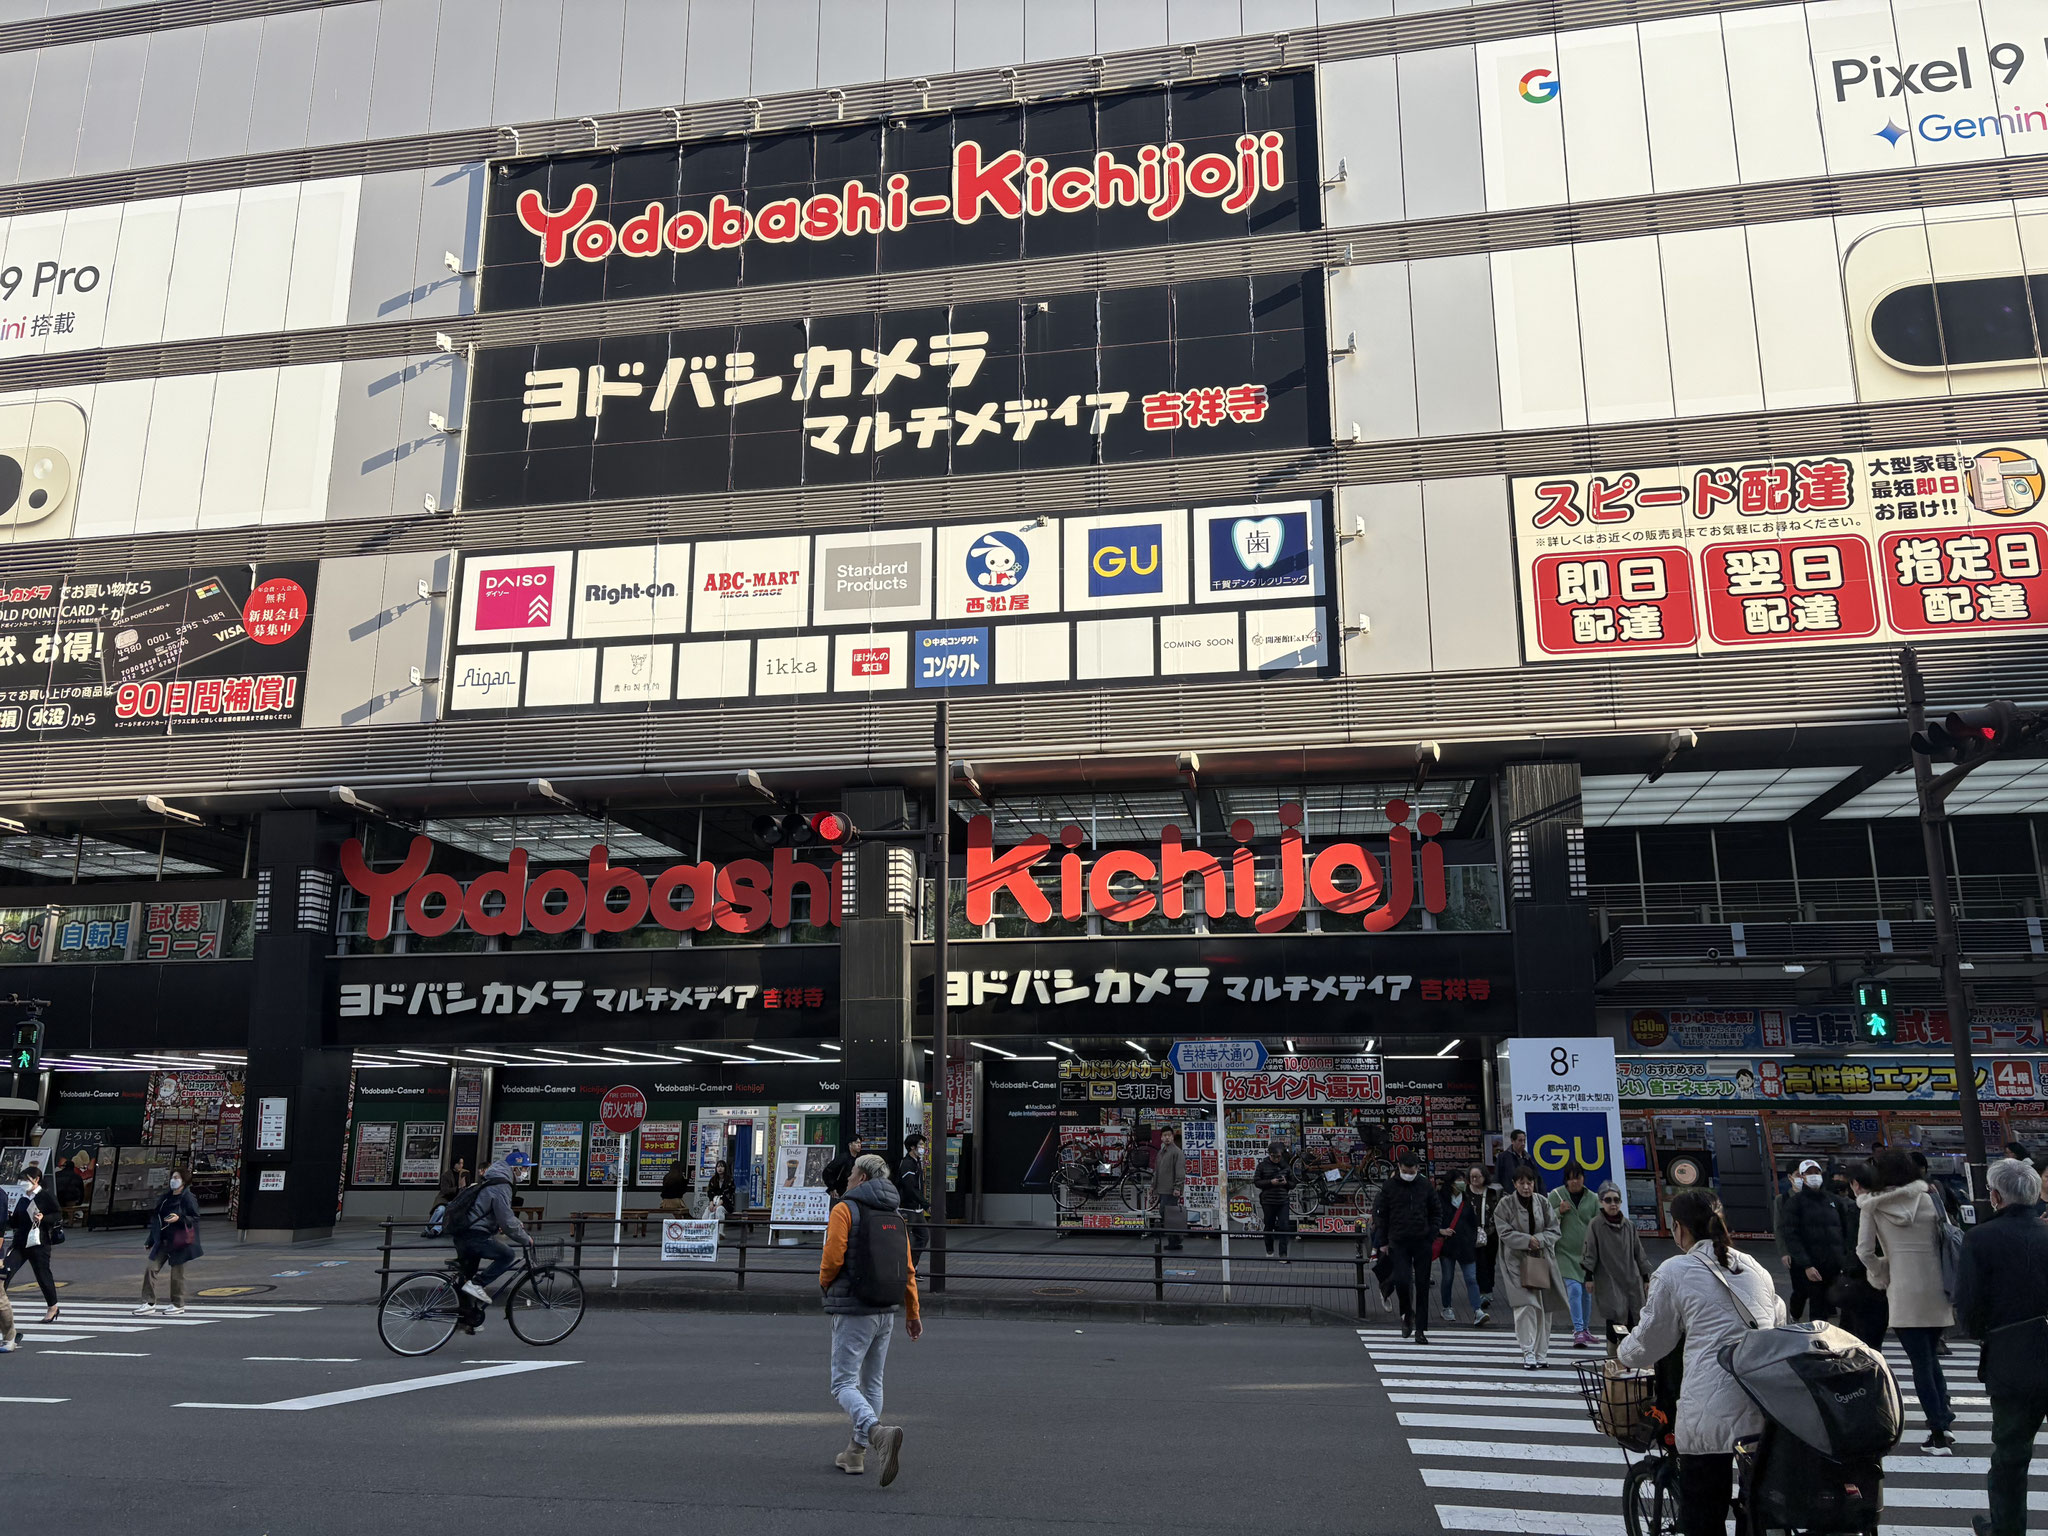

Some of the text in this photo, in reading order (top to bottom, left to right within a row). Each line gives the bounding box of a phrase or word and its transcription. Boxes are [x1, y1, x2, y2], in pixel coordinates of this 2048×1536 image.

[1831, 42, 2026, 103] Pixel 9
[516, 131, 1286, 268] Yodobashi-Kichijoji
[32, 261, 100, 298] Pro
[30, 311, 76, 338] 搭載
[522, 331, 990, 425] ヨドバシカメラ
[803, 383, 1270, 456] マルチメディア 吉祥寺
[1868, 452, 1975, 478] 大型家電も
[1532, 458, 1856, 529] スピード配達
[1871, 476, 1960, 500] 最短即日
[1874, 498, 1959, 521] お届け!!
[1244, 530, 1272, 556] 歯
[1093, 544, 1158, 578] GU
[1895, 533, 2044, 587] 指定日
[836, 561, 908, 578] Standard
[1724, 544, 1846, 597] 翌日
[60, 580, 152, 600] でお買い物なら
[485, 573, 547, 590] DAISO
[703, 571, 800, 594] ABC-MART
[836, 576, 908, 593] Products
[1211, 573, 1309, 591] 千賀デンタルクリニック
[1556, 556, 1670, 606] 即日
[264, 592, 287, 604] 無料
[485, 589, 509, 598] ダイソー
[719, 588, 783, 599] MEGA STAGE
[21, 606, 57, 620] POINT
[61, 604, 95, 618] CARD
[965, 594, 1030, 614] 西松屋
[1920, 583, 2032, 624] 配達
[130, 610, 149, 622] POINT
[249, 607, 300, 623] 新規会員
[1742, 594, 1843, 634] 配達
[212, 624, 246, 642] VISA
[253, 622, 292, 638] 募集中
[1571, 605, 1666, 644] 配達
[931, 635, 980, 648] 中央コンタクト
[1163, 637, 1235, 650] COMING SOON
[852, 652, 889, 663] ほけんの
[922, 653, 981, 680] コンタクト
[765, 657, 818, 677] ikka
[115, 674, 298, 719] 90日間補償!
[31, 708, 64, 727] 水没
[71, 713, 96, 727] から
[965, 798, 1447, 933] Kichijoji
[147, 903, 203, 933] 試乗
[946, 967, 1492, 1006] ヨドバシカメラ マルチメディア 吉祥寺
[339, 980, 826, 1017] ヨドバシカメラ マルチメディア 吉祥寺
[1763, 1012, 1784, 1045] 無料
[1788, 1013, 1860, 1045] 自転
[1971, 1025, 2041, 1047] コース
[1182, 1048, 1255, 1063] 吉祥寺大通り
[1058, 1059, 1173, 1080] ゴールドポイントカード
[1191, 1061, 1223, 1069] Kichijoji
[1284, 1057, 1334, 1073] 10,000円
[1645, 1063, 1706, 1077] おすすめする
[1997, 1063, 2030, 1085] 4階
[182, 1073, 225, 1081] Yodobashi
[1781, 1065, 1873, 1094] 高性能
[181, 1090, 224, 1098] Christmas
[189, 1082, 216, 1091] Happy
[360, 1087, 425, 1095] Yodobashi-Camera
[501, 1085, 577, 1094] Yodobashi-Camera
[654, 1083, 733, 1093] Yodobashi-Camera
[1116, 1083, 1172, 1100] ご利用で
[1548, 1084, 1580, 1093] 都内初の
[1647, 1078, 1737, 1098] 省エネモデル
[1998, 1085, 2034, 1096] 家電売場
[1515, 1093, 1614, 1103] フルラインストア(超大型店)
[1551, 1103, 1580, 1111] 営業中!
[602, 1101, 644, 1119] 防火水槽
[1183, 1122, 1215, 1132] 冷蔵庫
[1184, 1131, 1216, 1141] 洗濯機
[64, 1131, 102, 1142] とろける
[1185, 1140, 1213, 1149] テレビ
[1227, 1140, 1269, 1152] 電動自転車
[1532, 1133, 1605, 1171] GU
[1184, 1176, 1218, 1186] お届け・設置
[1188, 1185, 1216, 1195] できます!
